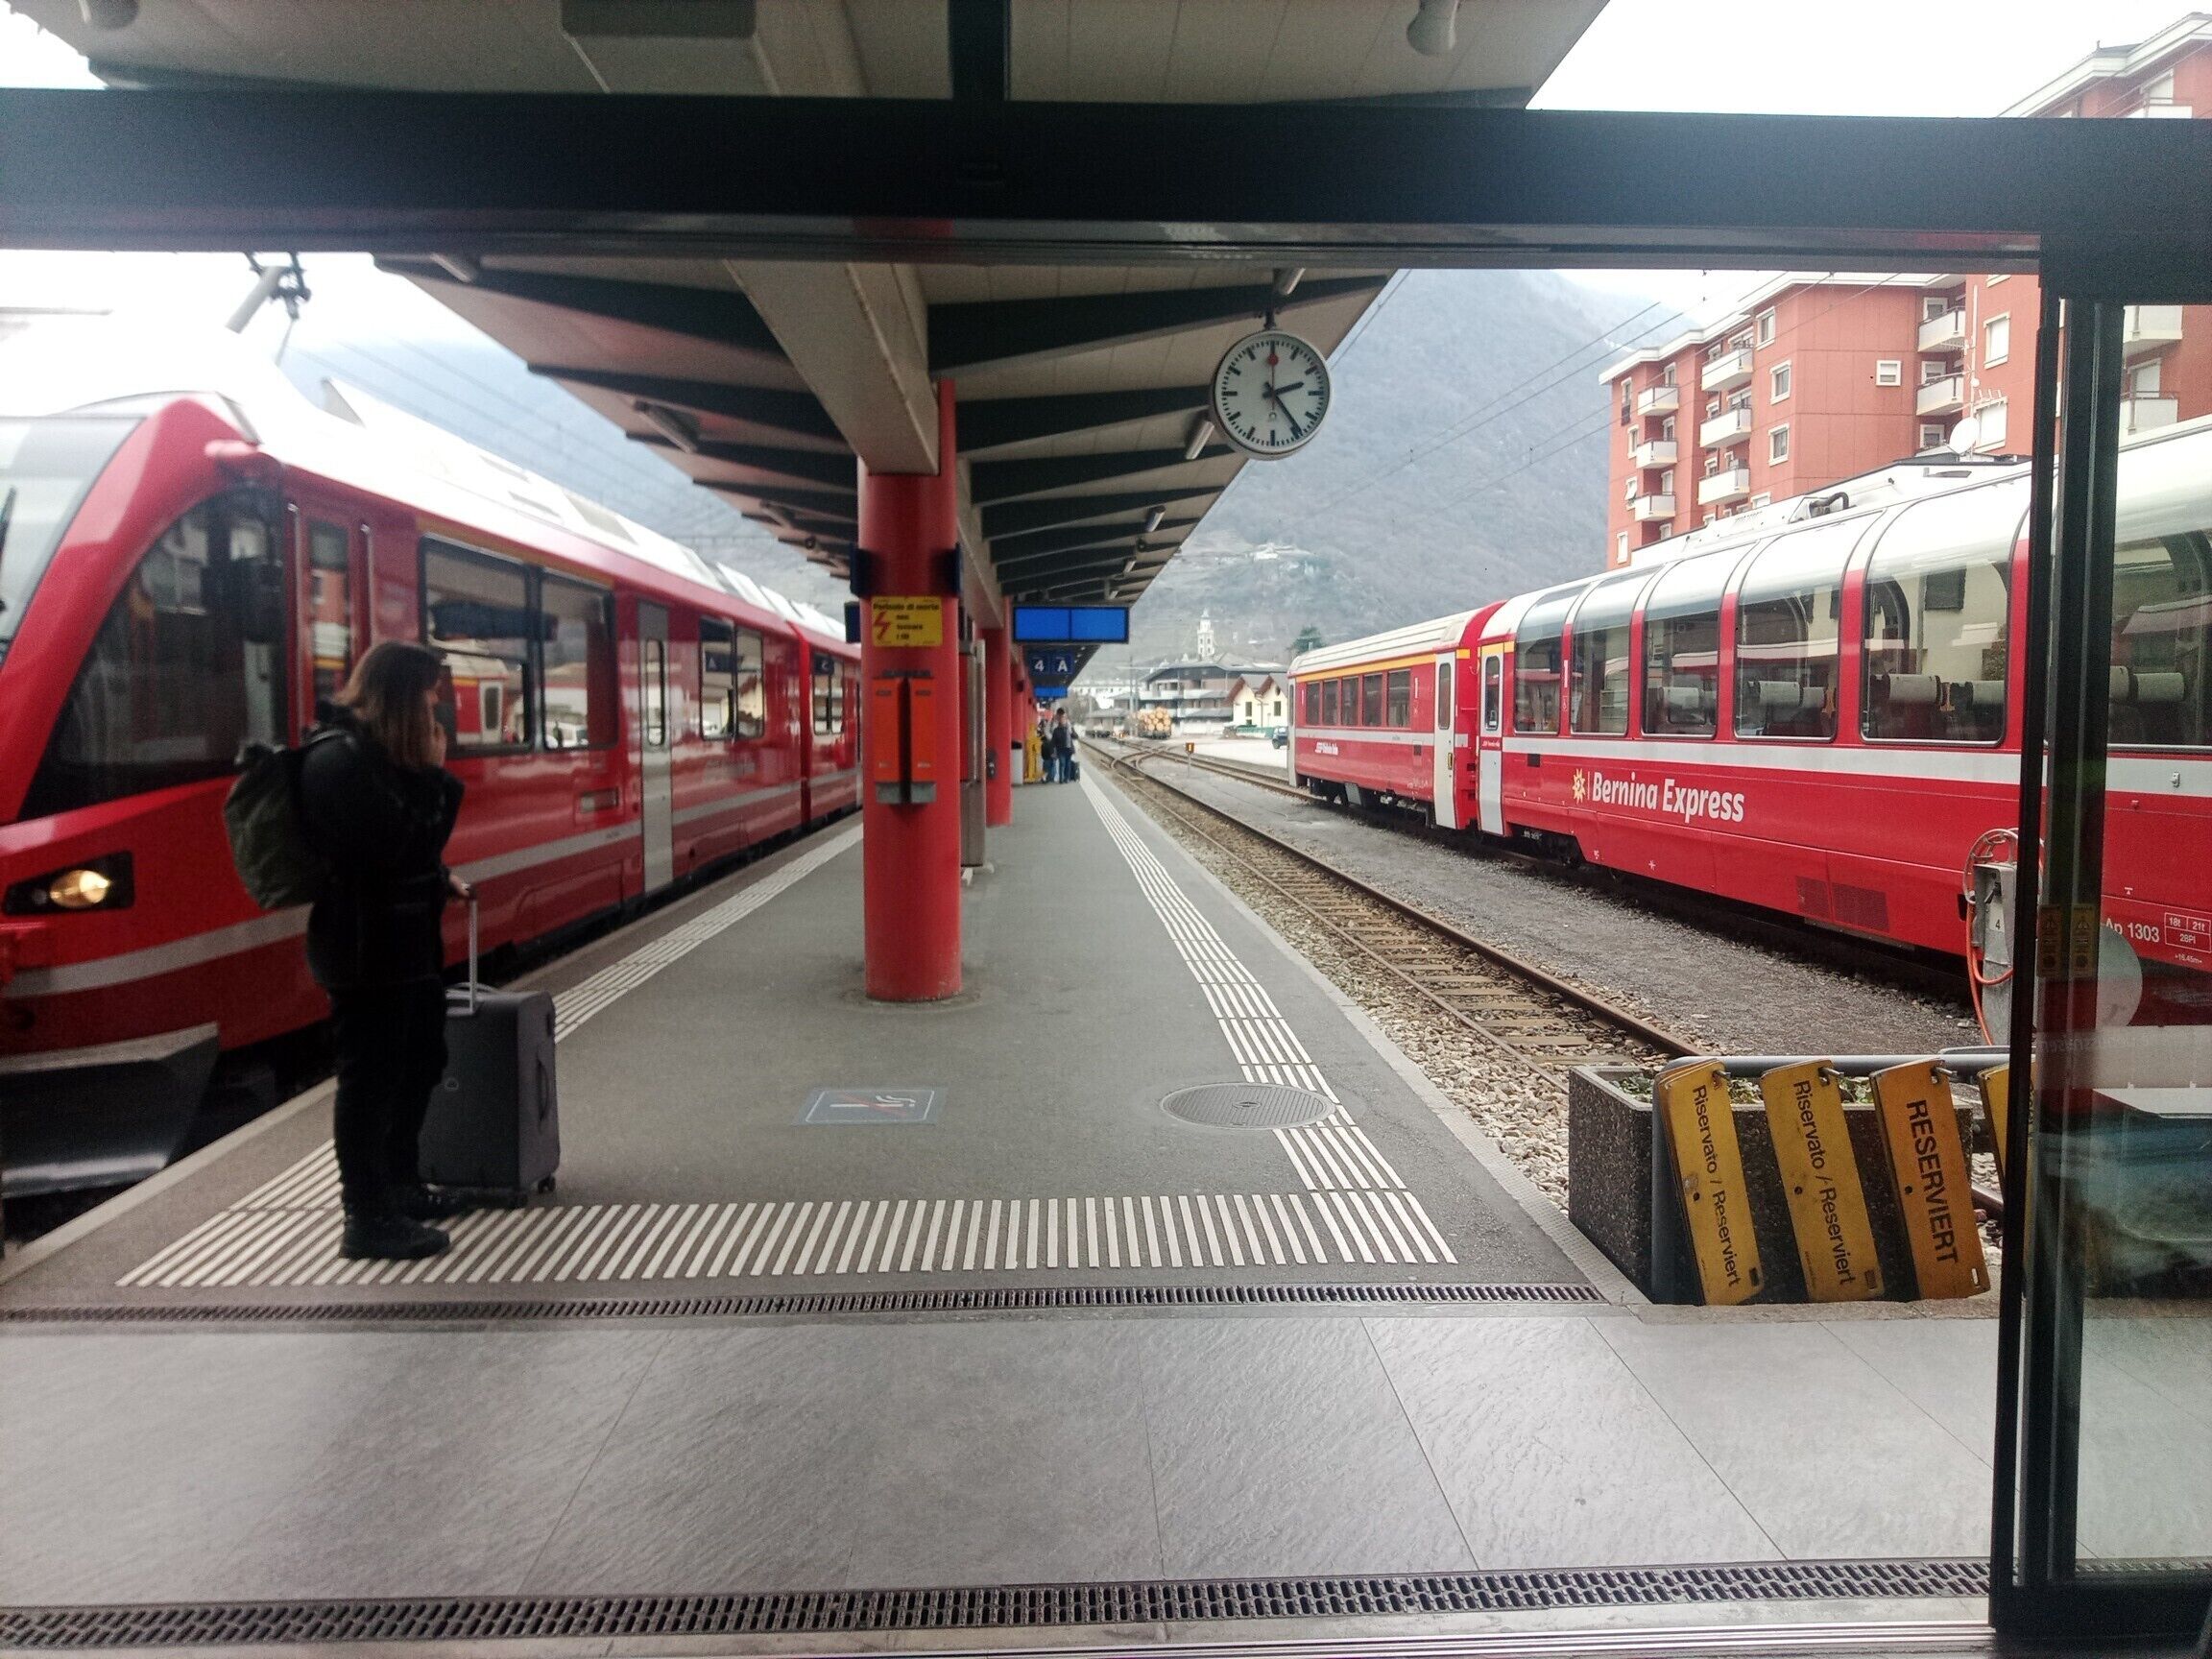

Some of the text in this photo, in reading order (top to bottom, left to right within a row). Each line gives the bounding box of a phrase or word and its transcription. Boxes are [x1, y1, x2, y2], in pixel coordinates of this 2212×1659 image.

[1034, 660, 1045, 672] 4
[1057, 660, 1068, 672] A
[1592, 771, 1744, 824] Bernina Express
[1995, 919, 2001, 929] 4
[2169, 917, 2181, 927] 18t
[2193, 922, 2205, 932] 21t
[2128, 922, 2160, 943] 1303
[1693, 1084, 1718, 1174] Riservato
[1712, 1190, 1741, 1287] Reserviert
[1793, 1080, 1826, 1169] Riservato
[1819, 1187, 1856, 1286] Reserviert
[1906, 1099, 1959, 1263] RESERVIERT
